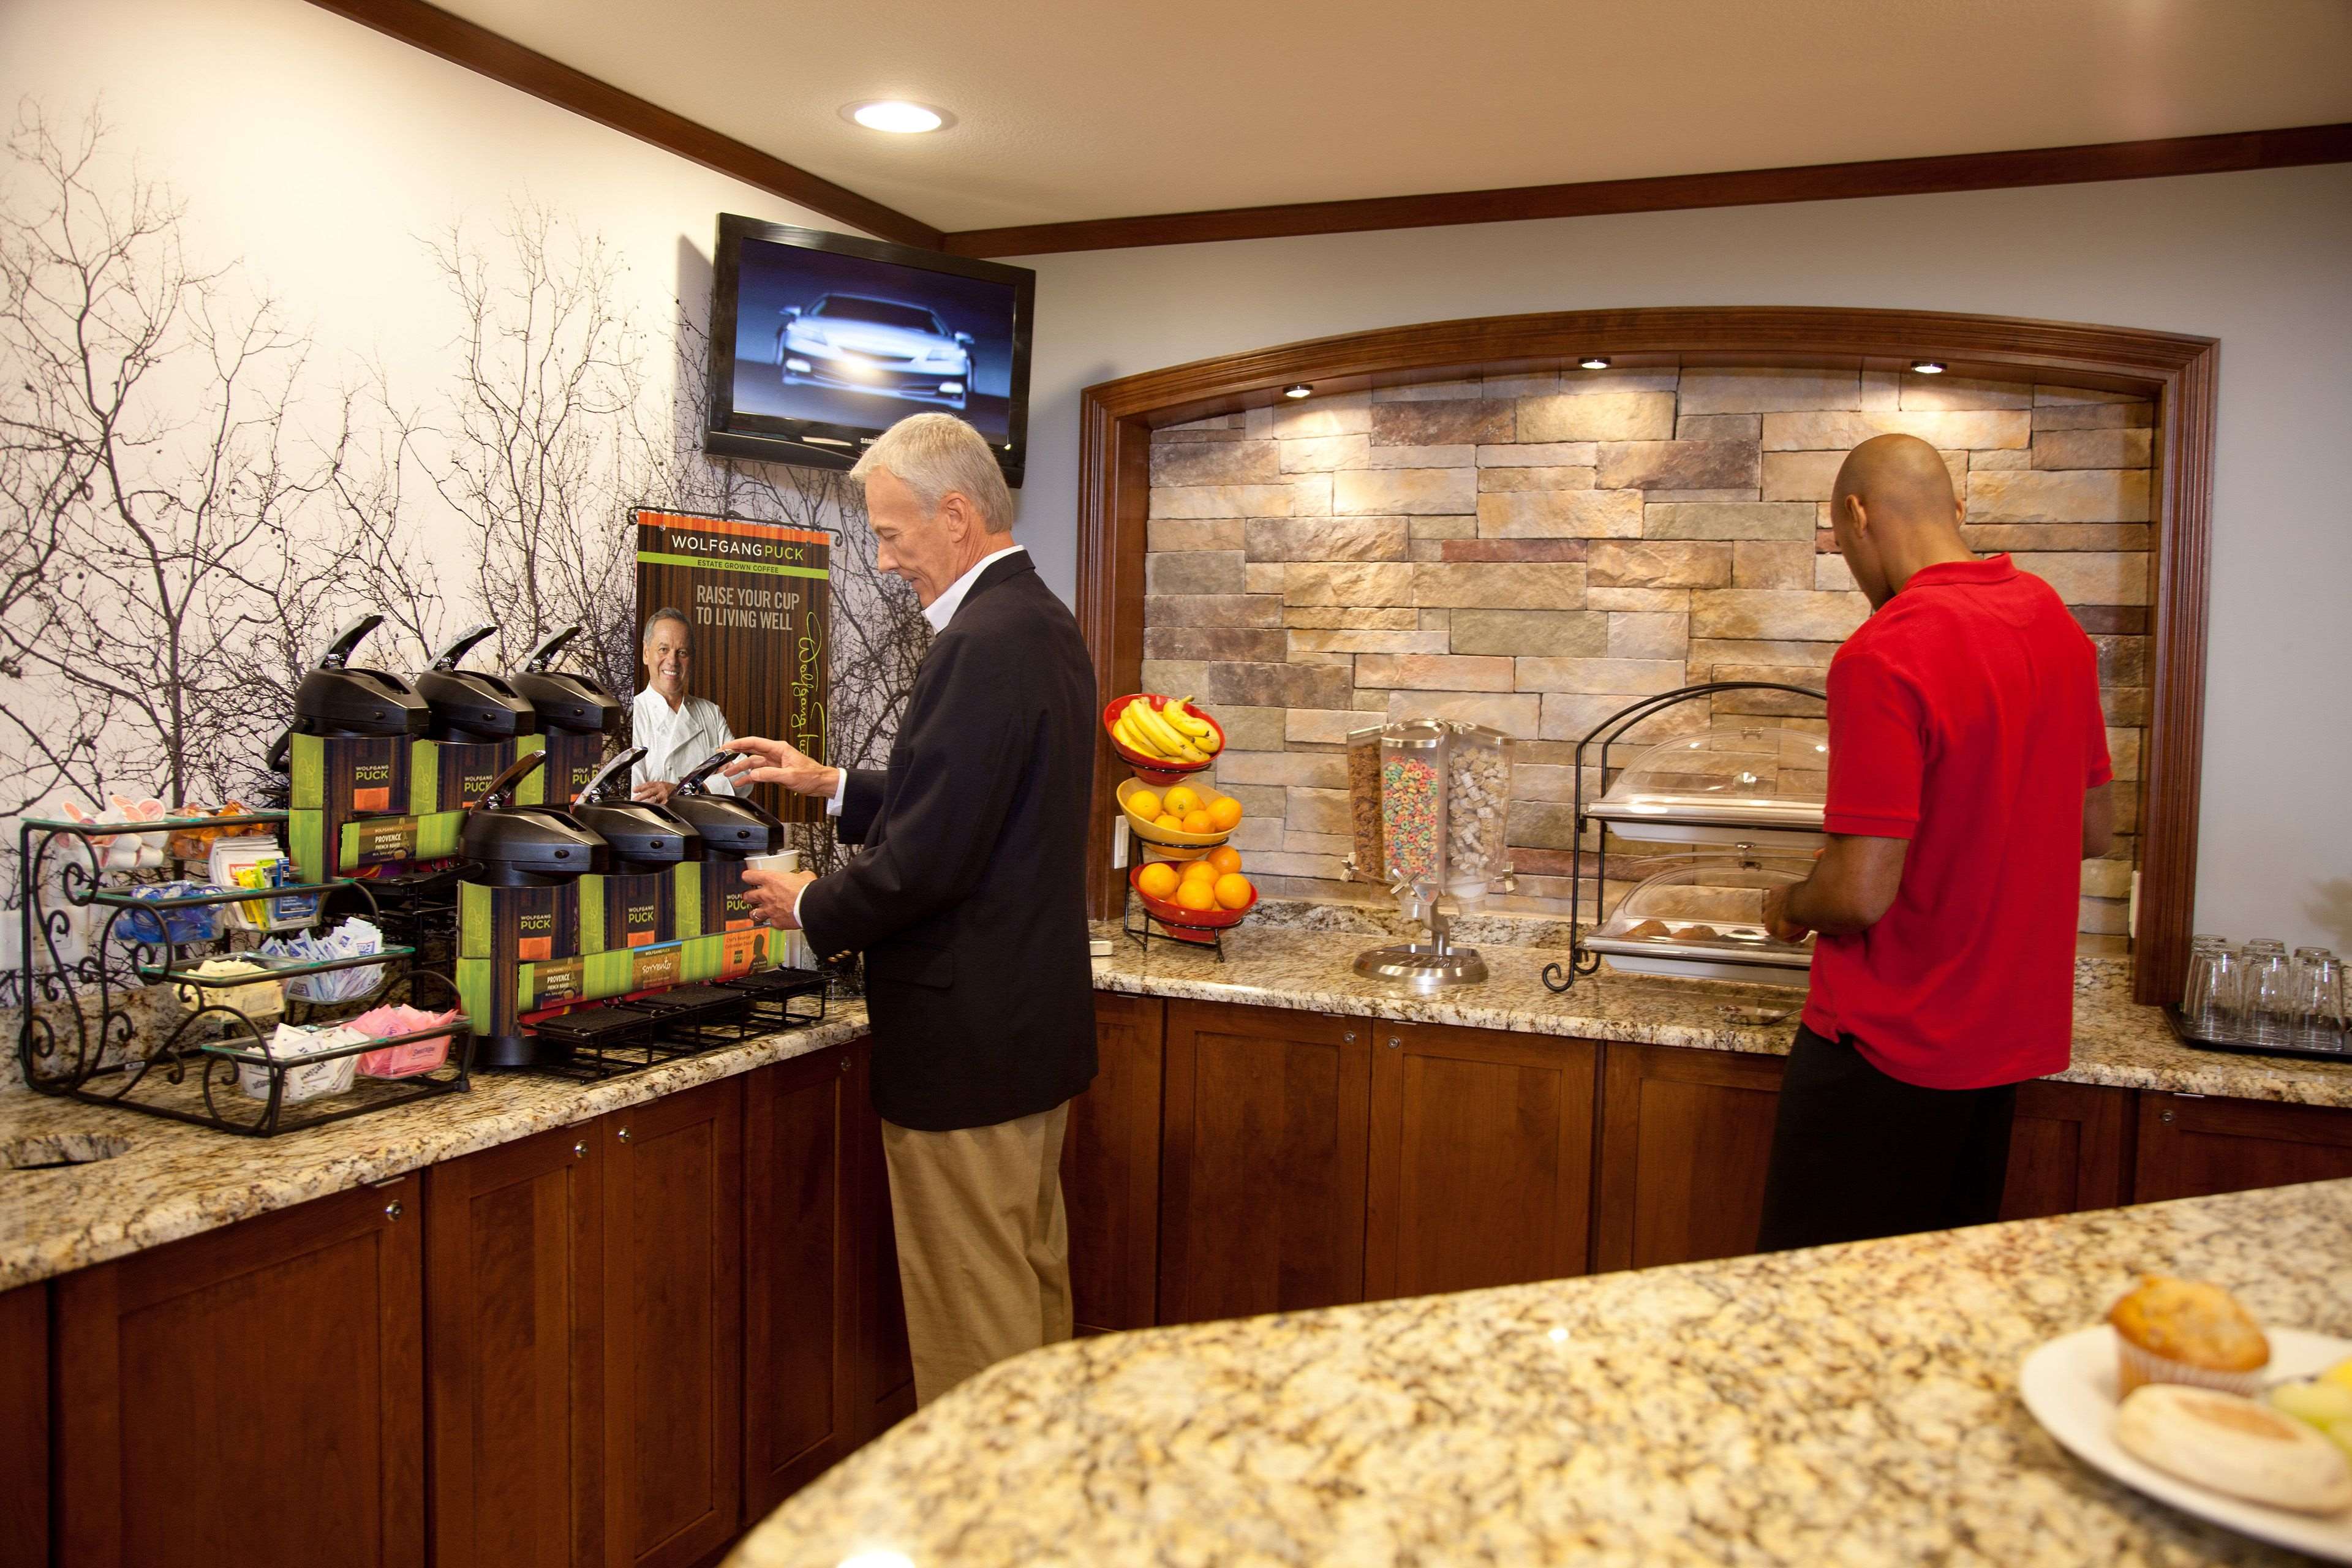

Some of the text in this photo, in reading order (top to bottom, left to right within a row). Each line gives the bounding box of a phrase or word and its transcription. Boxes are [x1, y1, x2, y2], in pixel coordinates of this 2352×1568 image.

[697, 585, 800, 610] RAISE YOUR CUP
[696, 606, 793, 630] TO LIVING WELL
[356, 771, 389, 780] PUCK
[573, 774, 590, 785] PU
[375, 832, 402, 843] PROVENCE
[628, 911, 654, 923] PUCK
[521, 919, 551, 930] PUCK
[547, 972, 570, 984] PROVENCE
